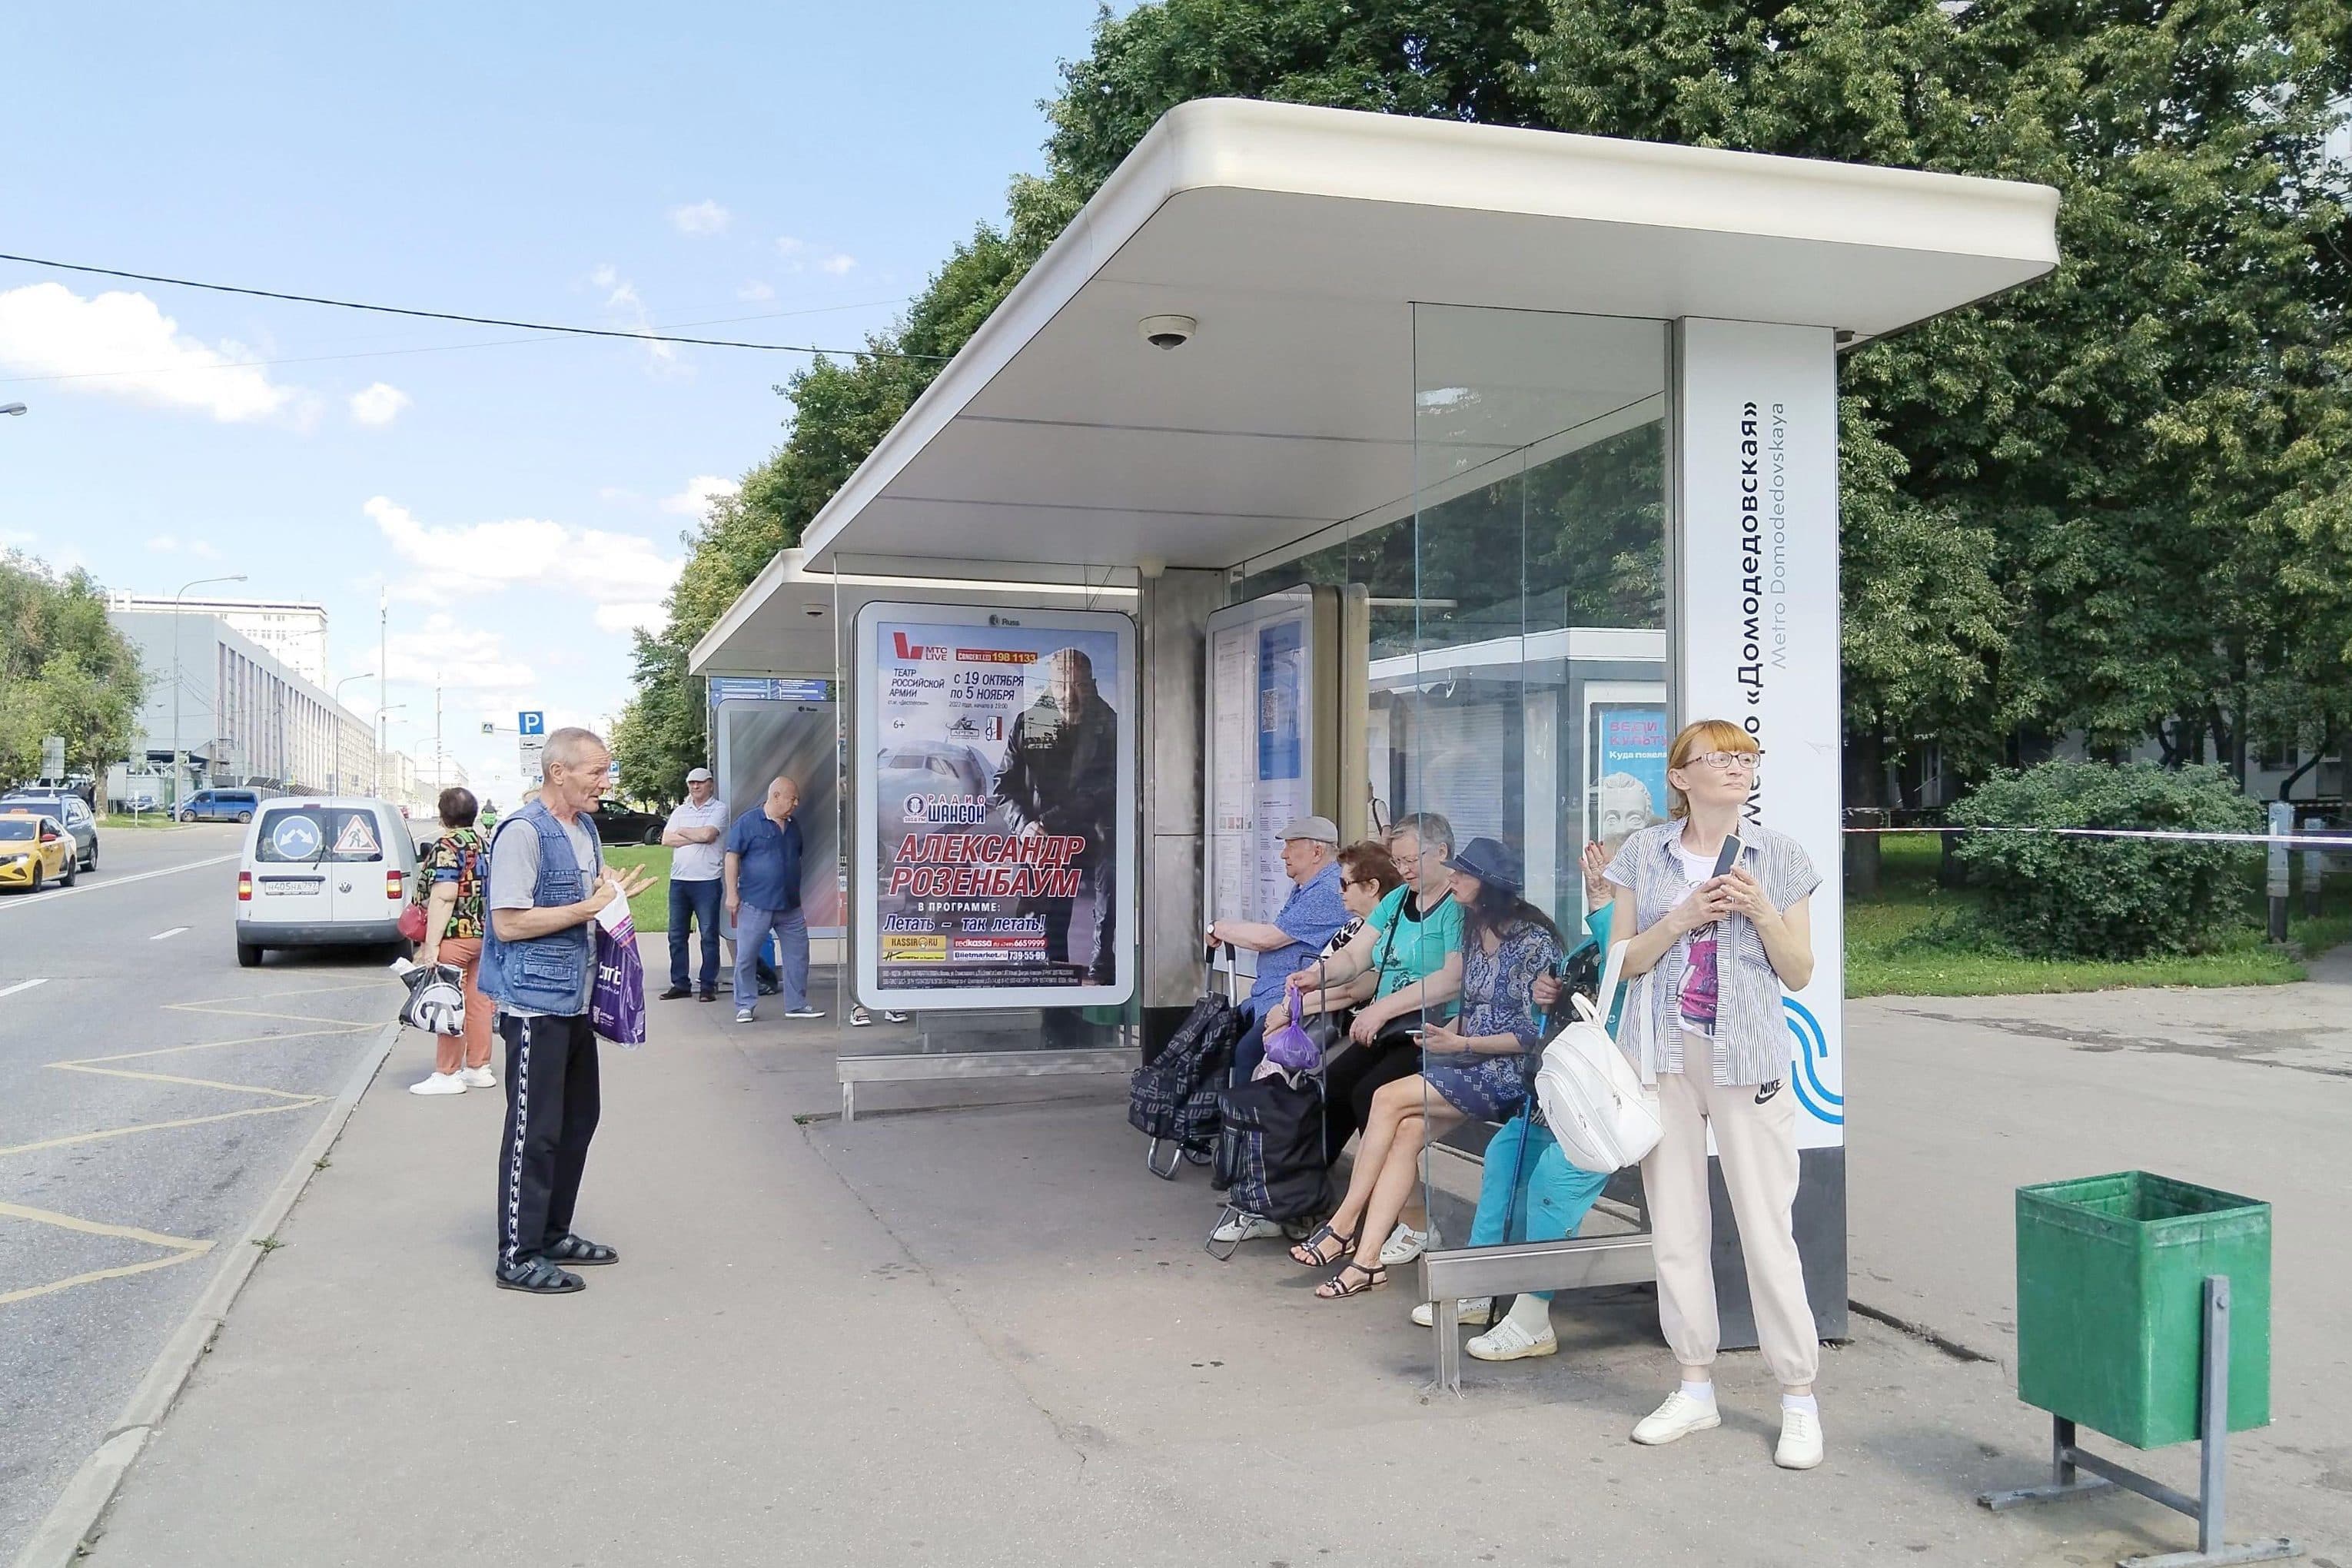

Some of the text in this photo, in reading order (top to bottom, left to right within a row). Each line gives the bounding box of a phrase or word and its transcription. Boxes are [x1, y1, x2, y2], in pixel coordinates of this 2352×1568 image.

[1768, 402, 1788, 669] Metro Domodedovskaya
[1737, 400, 1764, 706] «Домодедовская»
[894, 668, 916, 677] ТЕАТР
[964, 671, 979, 685] 19
[982, 674, 1024, 687] ОКТЯБРЯ
[892, 678, 945, 689] РОССИЙСКОЙ
[889, 689, 918, 697] АРМИИ
[965, 686, 974, 699] 5
[976, 689, 1015, 700] НОЯБРЯ
[524, 713, 540, 733] P
[893, 720, 905, 729] 6+
[1610, 751, 1633, 761] Куда
[928, 795, 985, 805] РАДИО
[928, 805, 985, 823] ШАНСОН
[895, 833, 1085, 869] АЛЕКСАНДР
[889, 867, 1082, 898] РОЗЕНБАУМ
[918, 902, 1001, 912] В ПРОГРАММЕ:
[884, 914, 935, 932] Летать
[962, 917, 987, 931] так
[992, 915, 1046, 932] летать!
[1759, 1078, 1780, 1095] NIKE
